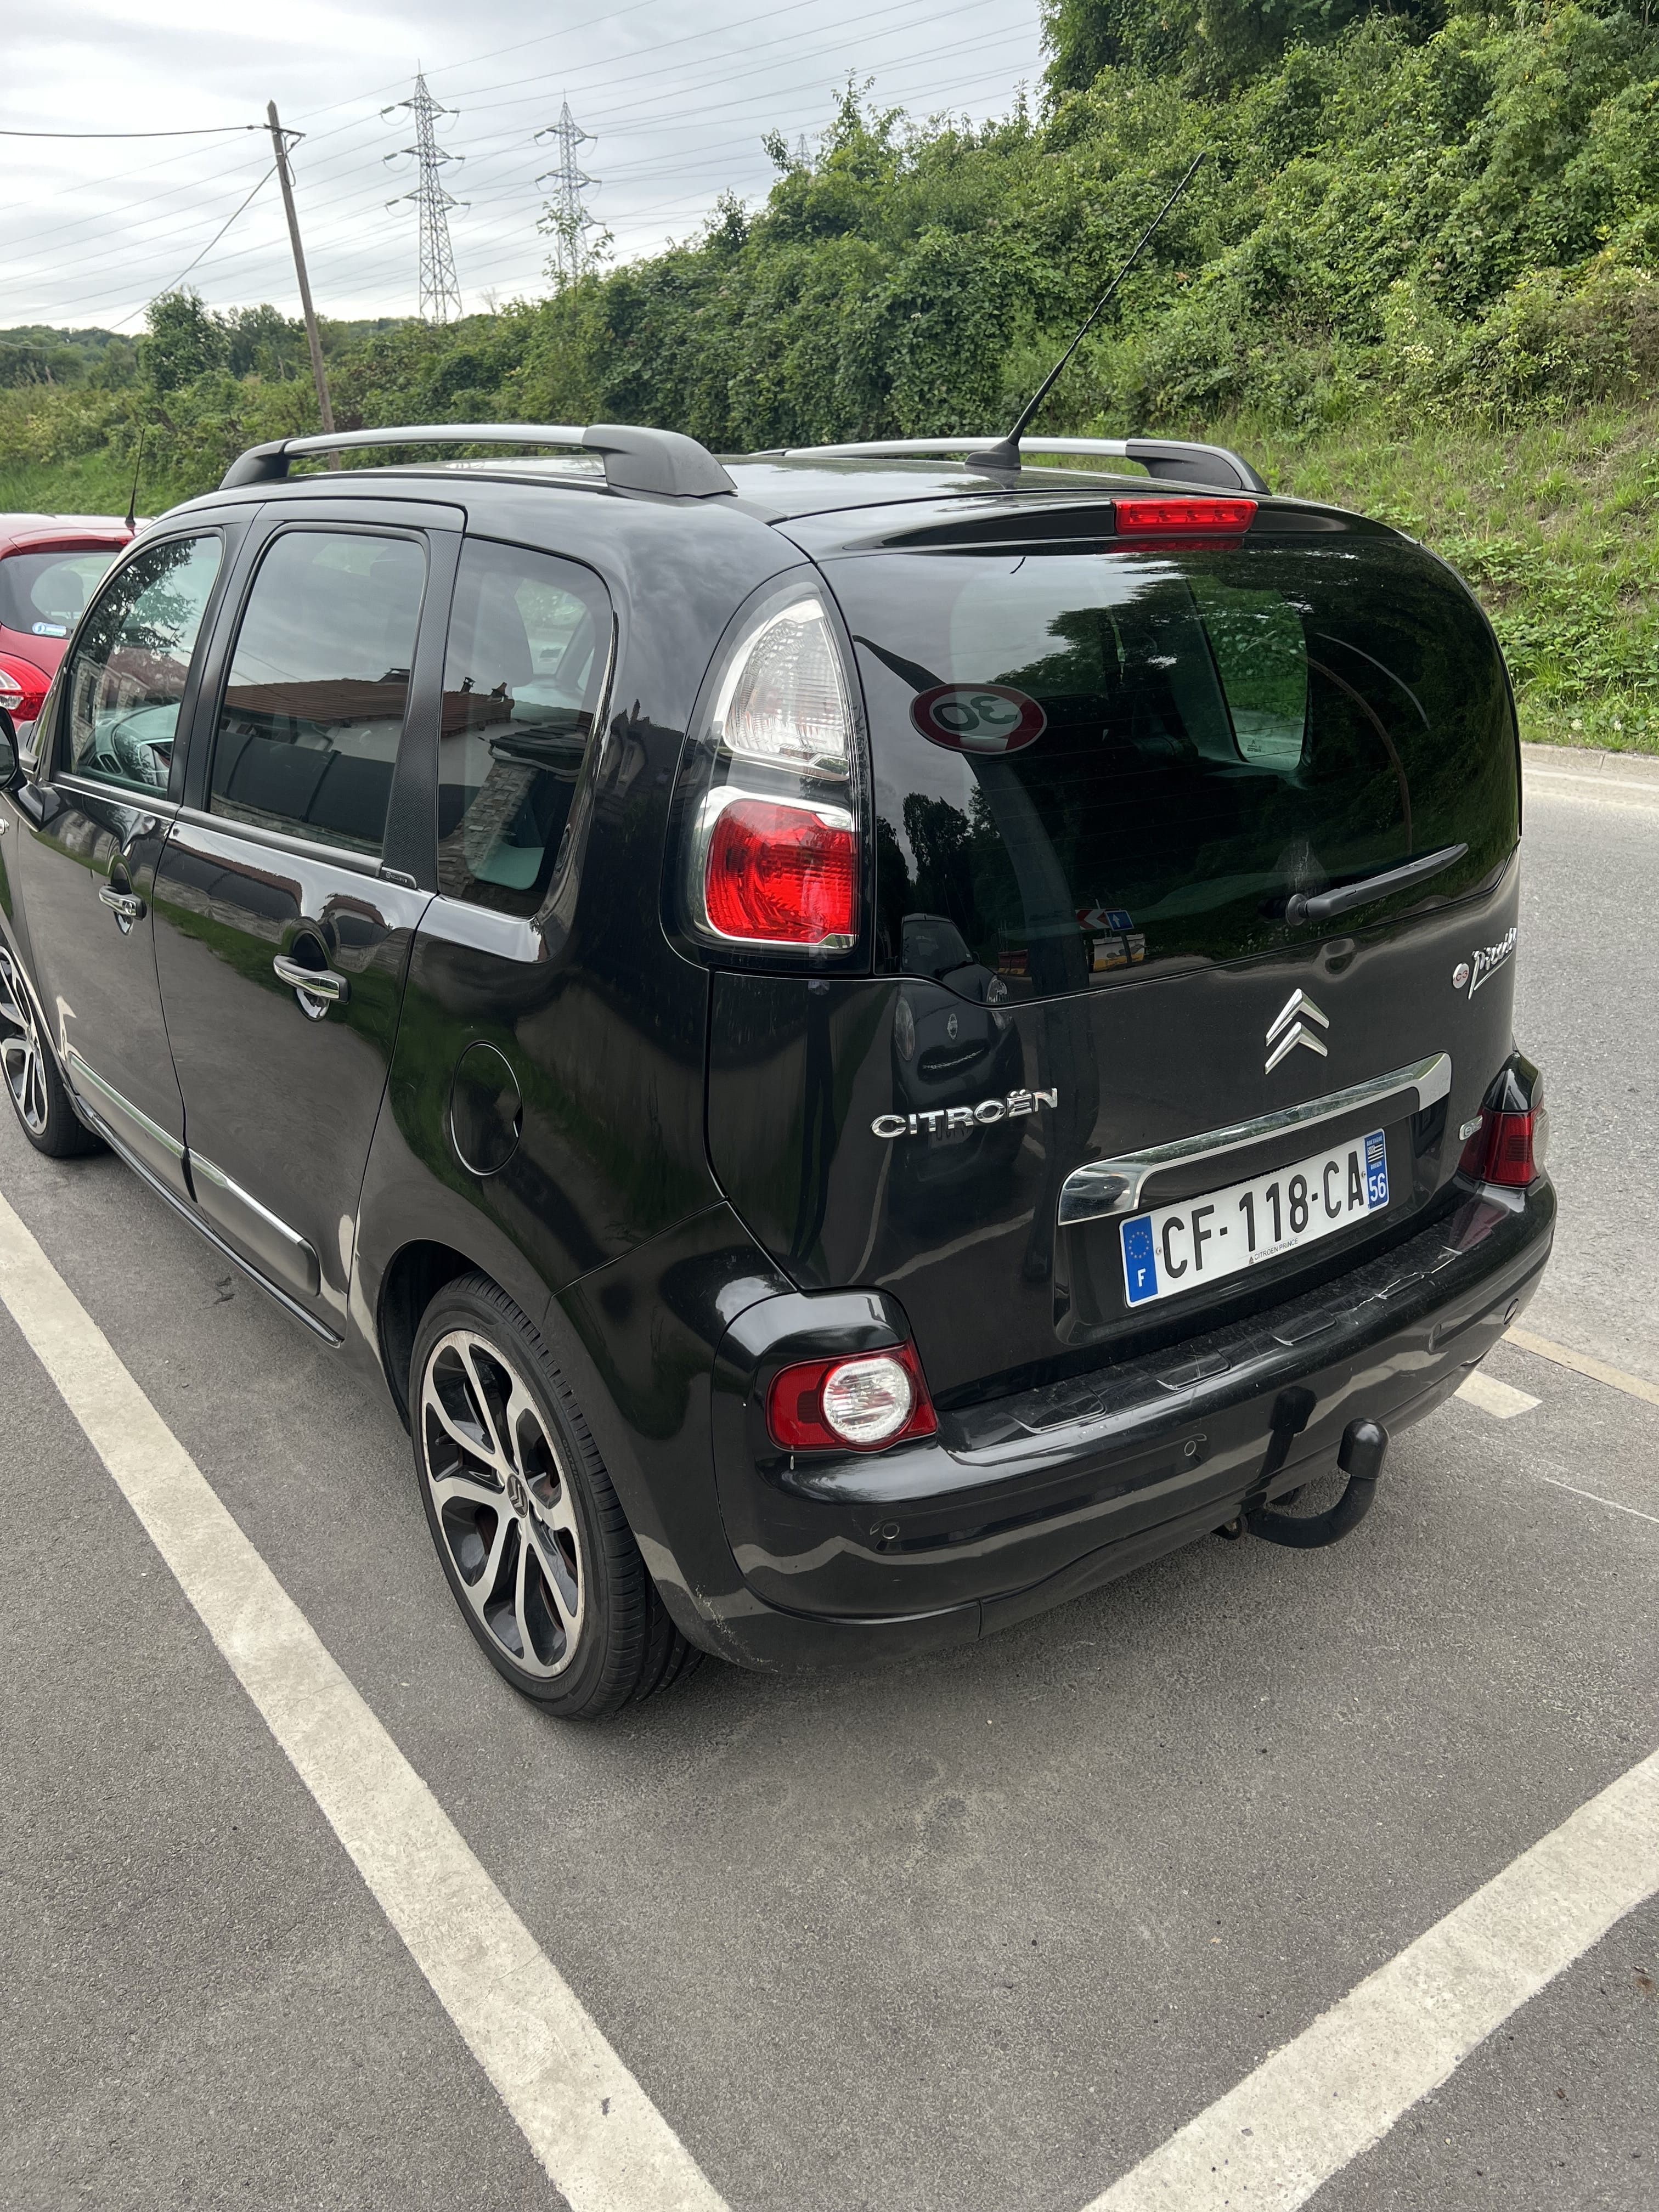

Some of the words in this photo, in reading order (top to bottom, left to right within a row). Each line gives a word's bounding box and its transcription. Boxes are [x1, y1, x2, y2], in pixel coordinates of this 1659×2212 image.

[1455, 969, 1469, 981] C3
[871, 1087, 1058, 1138] CITROËN
[1369, 1172, 1386, 1201] 56
[1161, 1150, 1364, 1279] CF-118-CA
[1254, 1246, 1279, 1261] CITROEN
[1137, 1268, 1147, 1288] F
